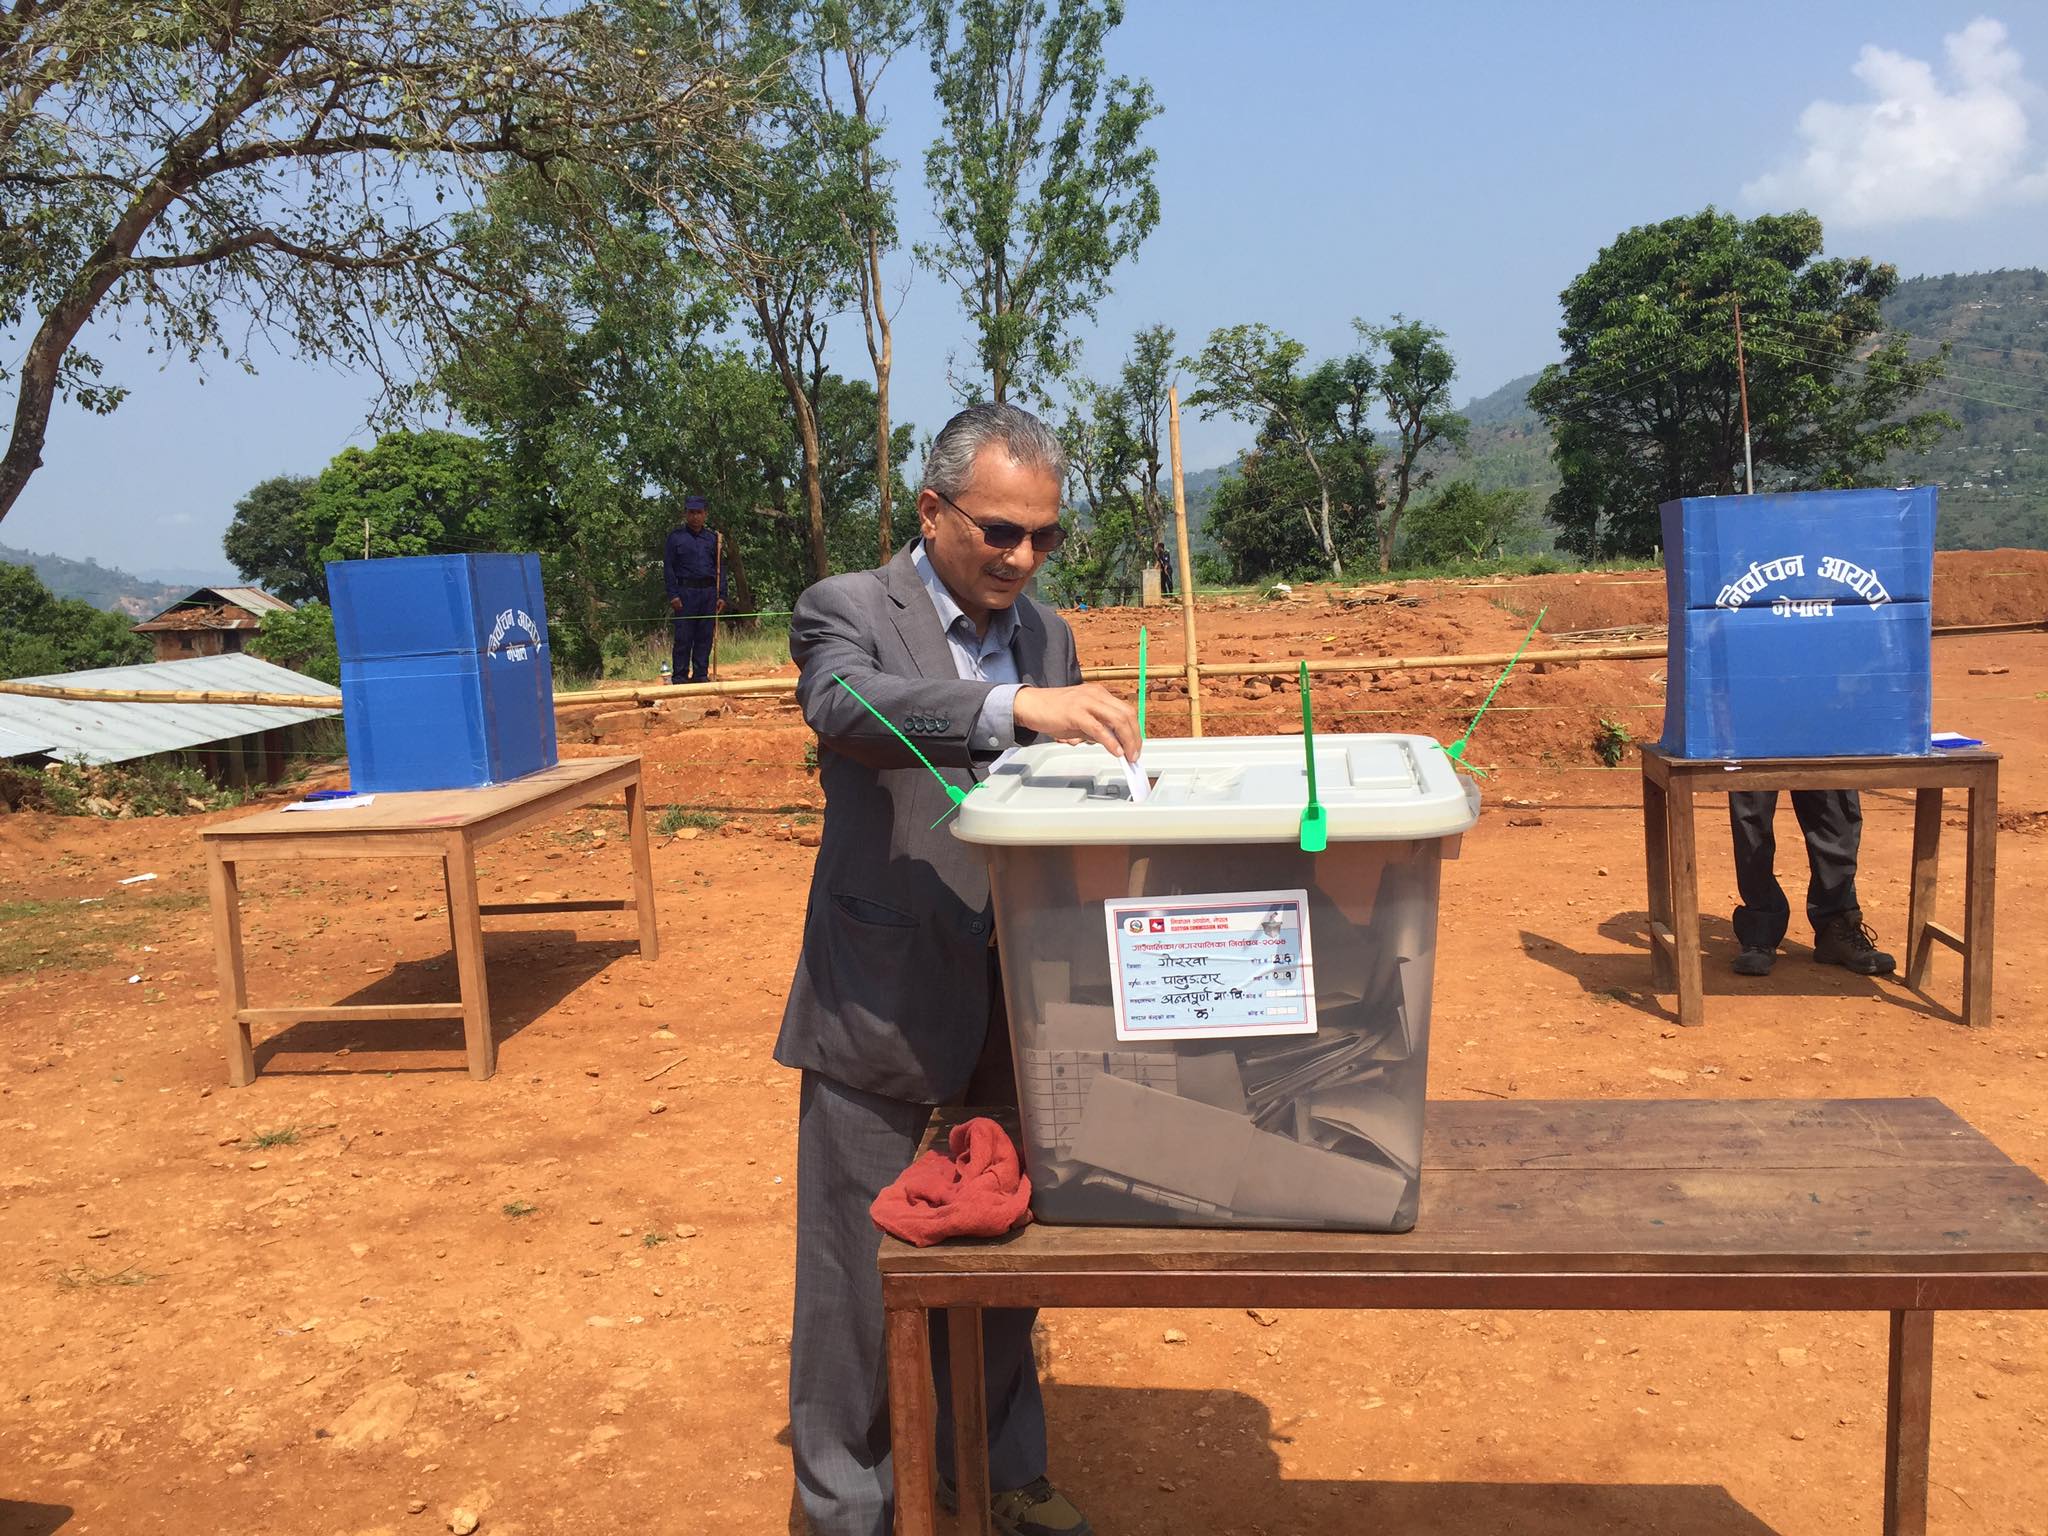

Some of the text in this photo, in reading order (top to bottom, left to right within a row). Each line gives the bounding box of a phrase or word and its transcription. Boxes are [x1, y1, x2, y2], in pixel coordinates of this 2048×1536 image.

[1716, 555, 1892, 613] निर्वाचन आयोग
[1771, 595, 1836, 618] नेपाल
